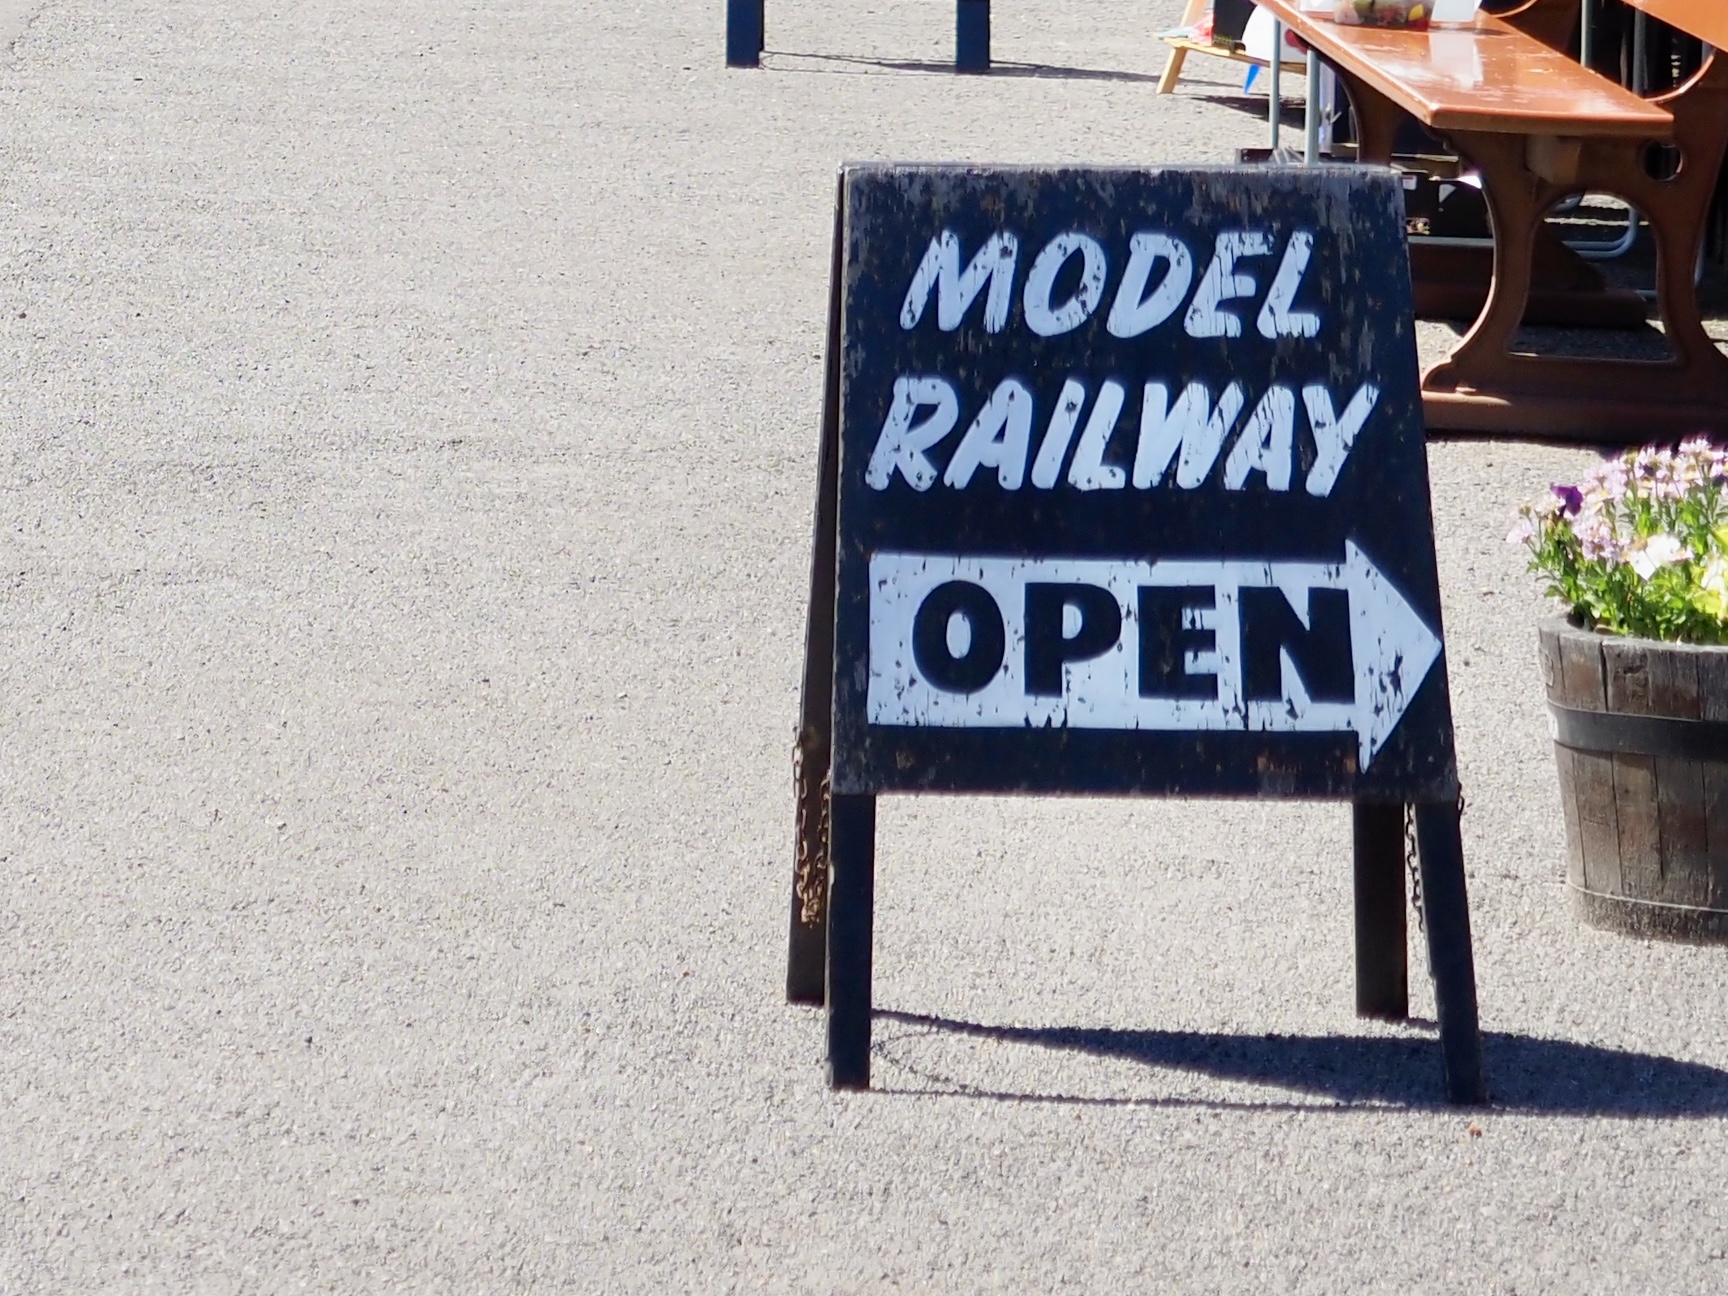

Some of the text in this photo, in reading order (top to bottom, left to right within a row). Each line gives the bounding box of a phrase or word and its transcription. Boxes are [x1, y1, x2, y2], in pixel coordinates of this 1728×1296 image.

[899, 229, 1321, 339] MODEL
[864, 375, 1380, 498] RAILWAY
[912, 579, 1356, 705] OPEN
